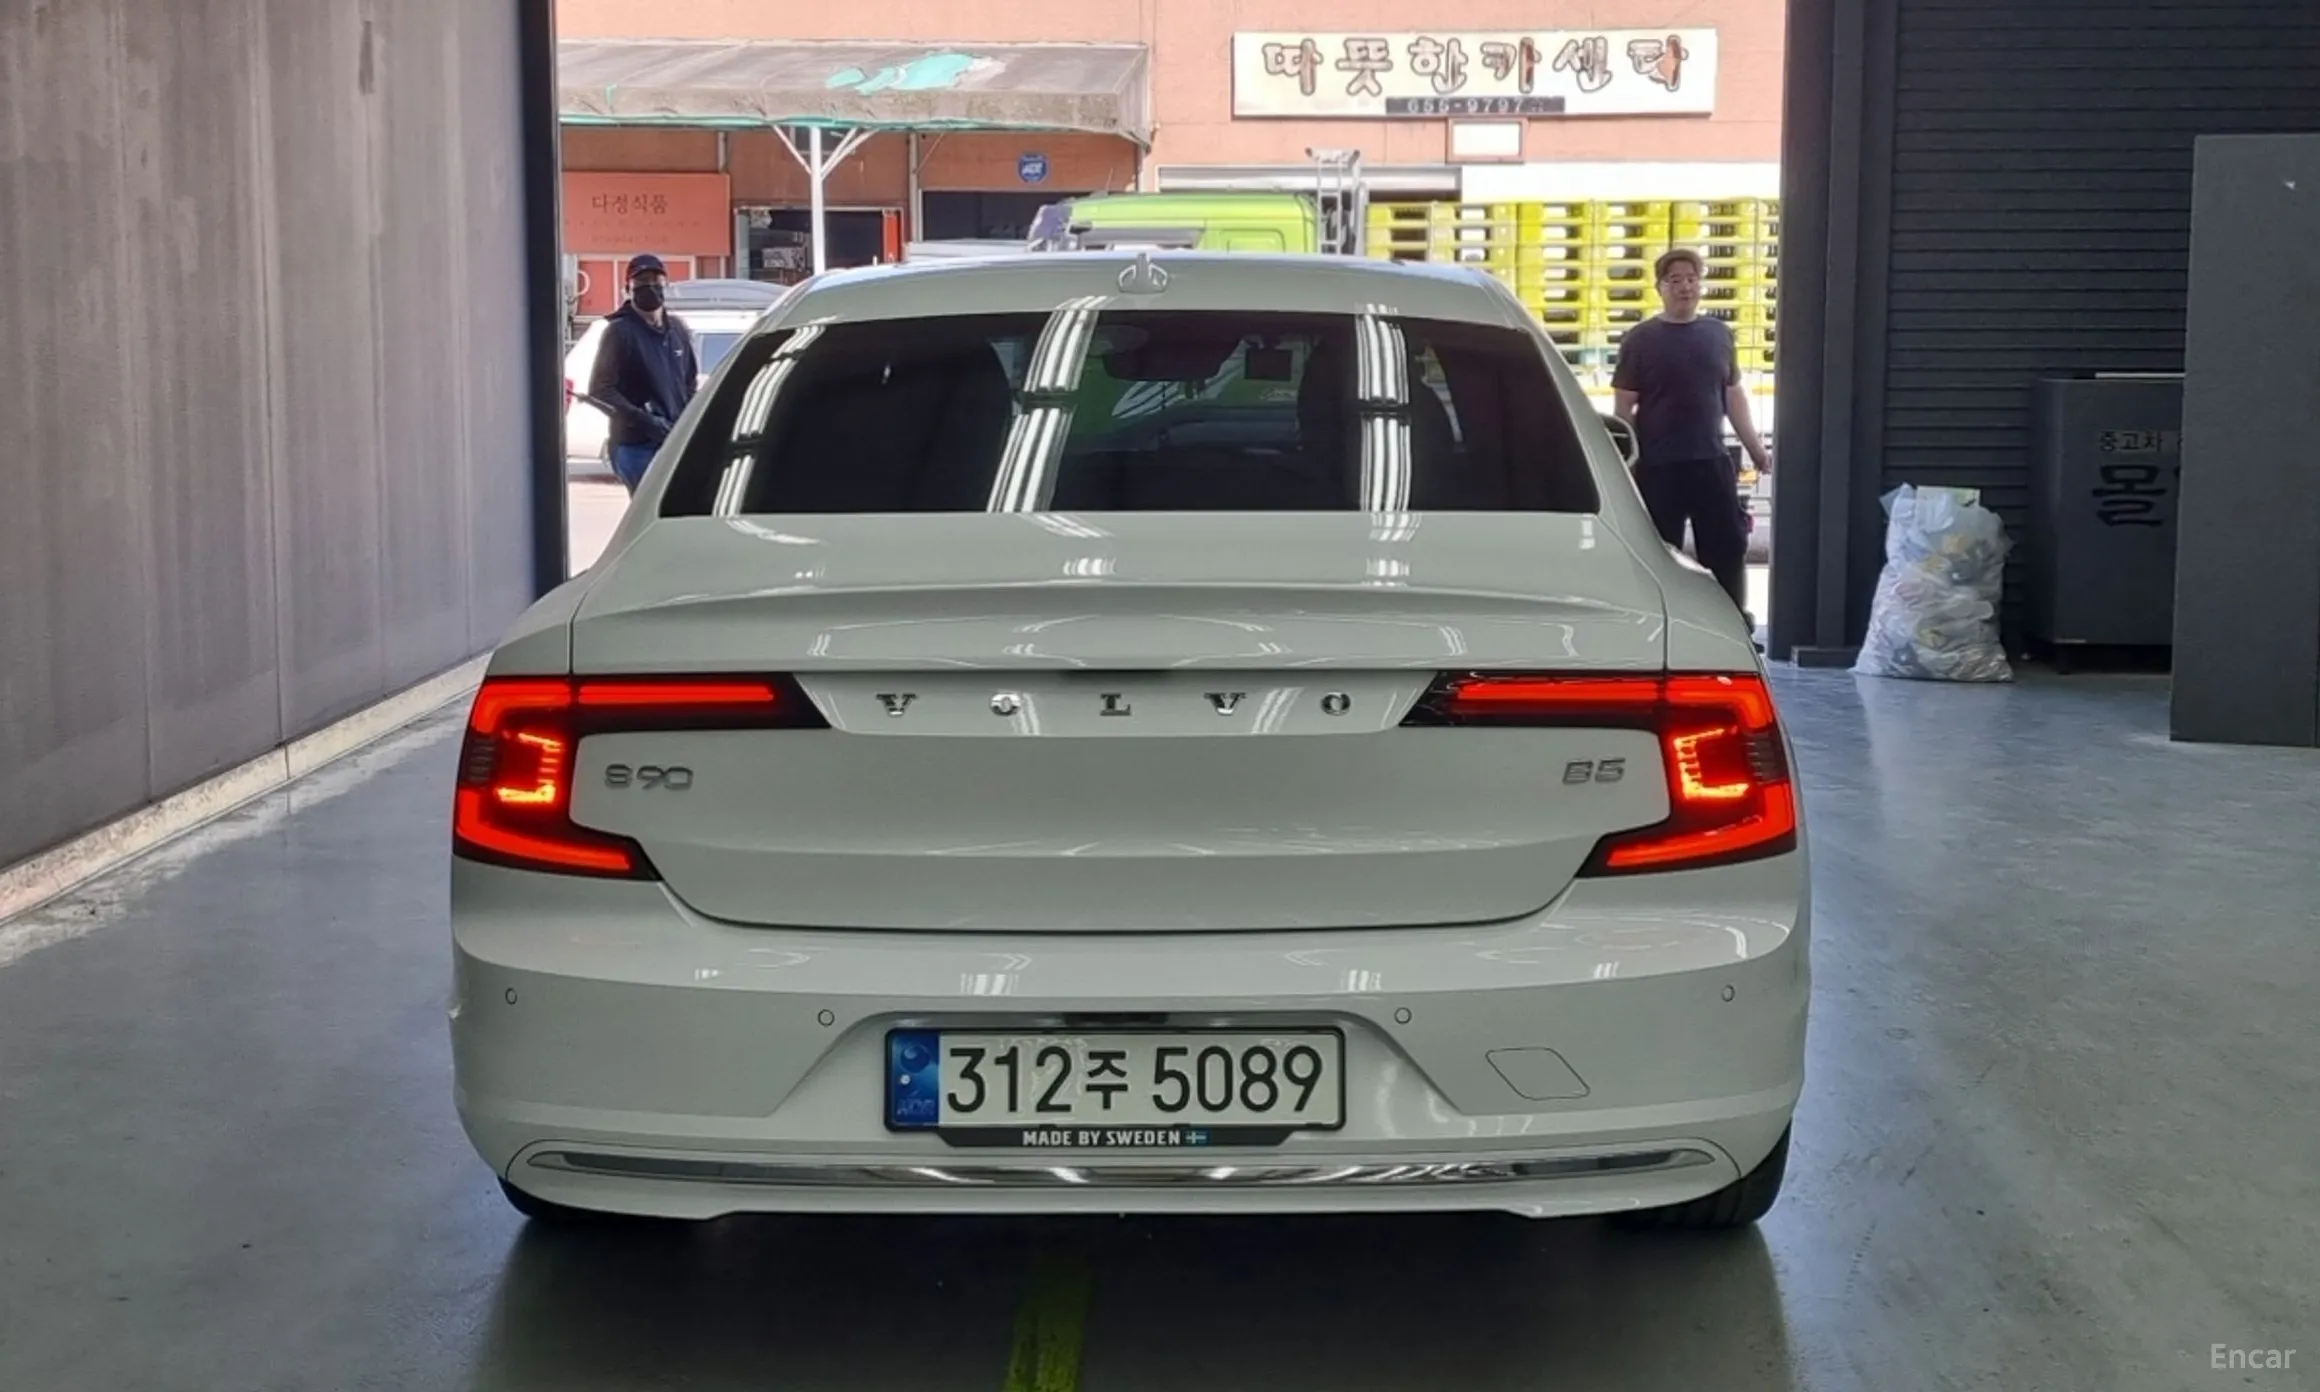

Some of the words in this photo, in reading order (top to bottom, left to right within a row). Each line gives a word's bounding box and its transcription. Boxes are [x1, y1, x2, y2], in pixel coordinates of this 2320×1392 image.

[2092, 464, 2181, 527] 몰
[876, 692, 1352, 717] VOLVO
[604, 763, 694, 791] S90
[1562, 757, 1627, 786] B5
[947, 1045, 1129, 1114] 312주
[1152, 1045, 1324, 1114] 5089
[1022, 1130, 1072, 1147] MADE
[1078, 1130, 1101, 1146] BY
[1106, 1130, 1182, 1146] SWEDEN
